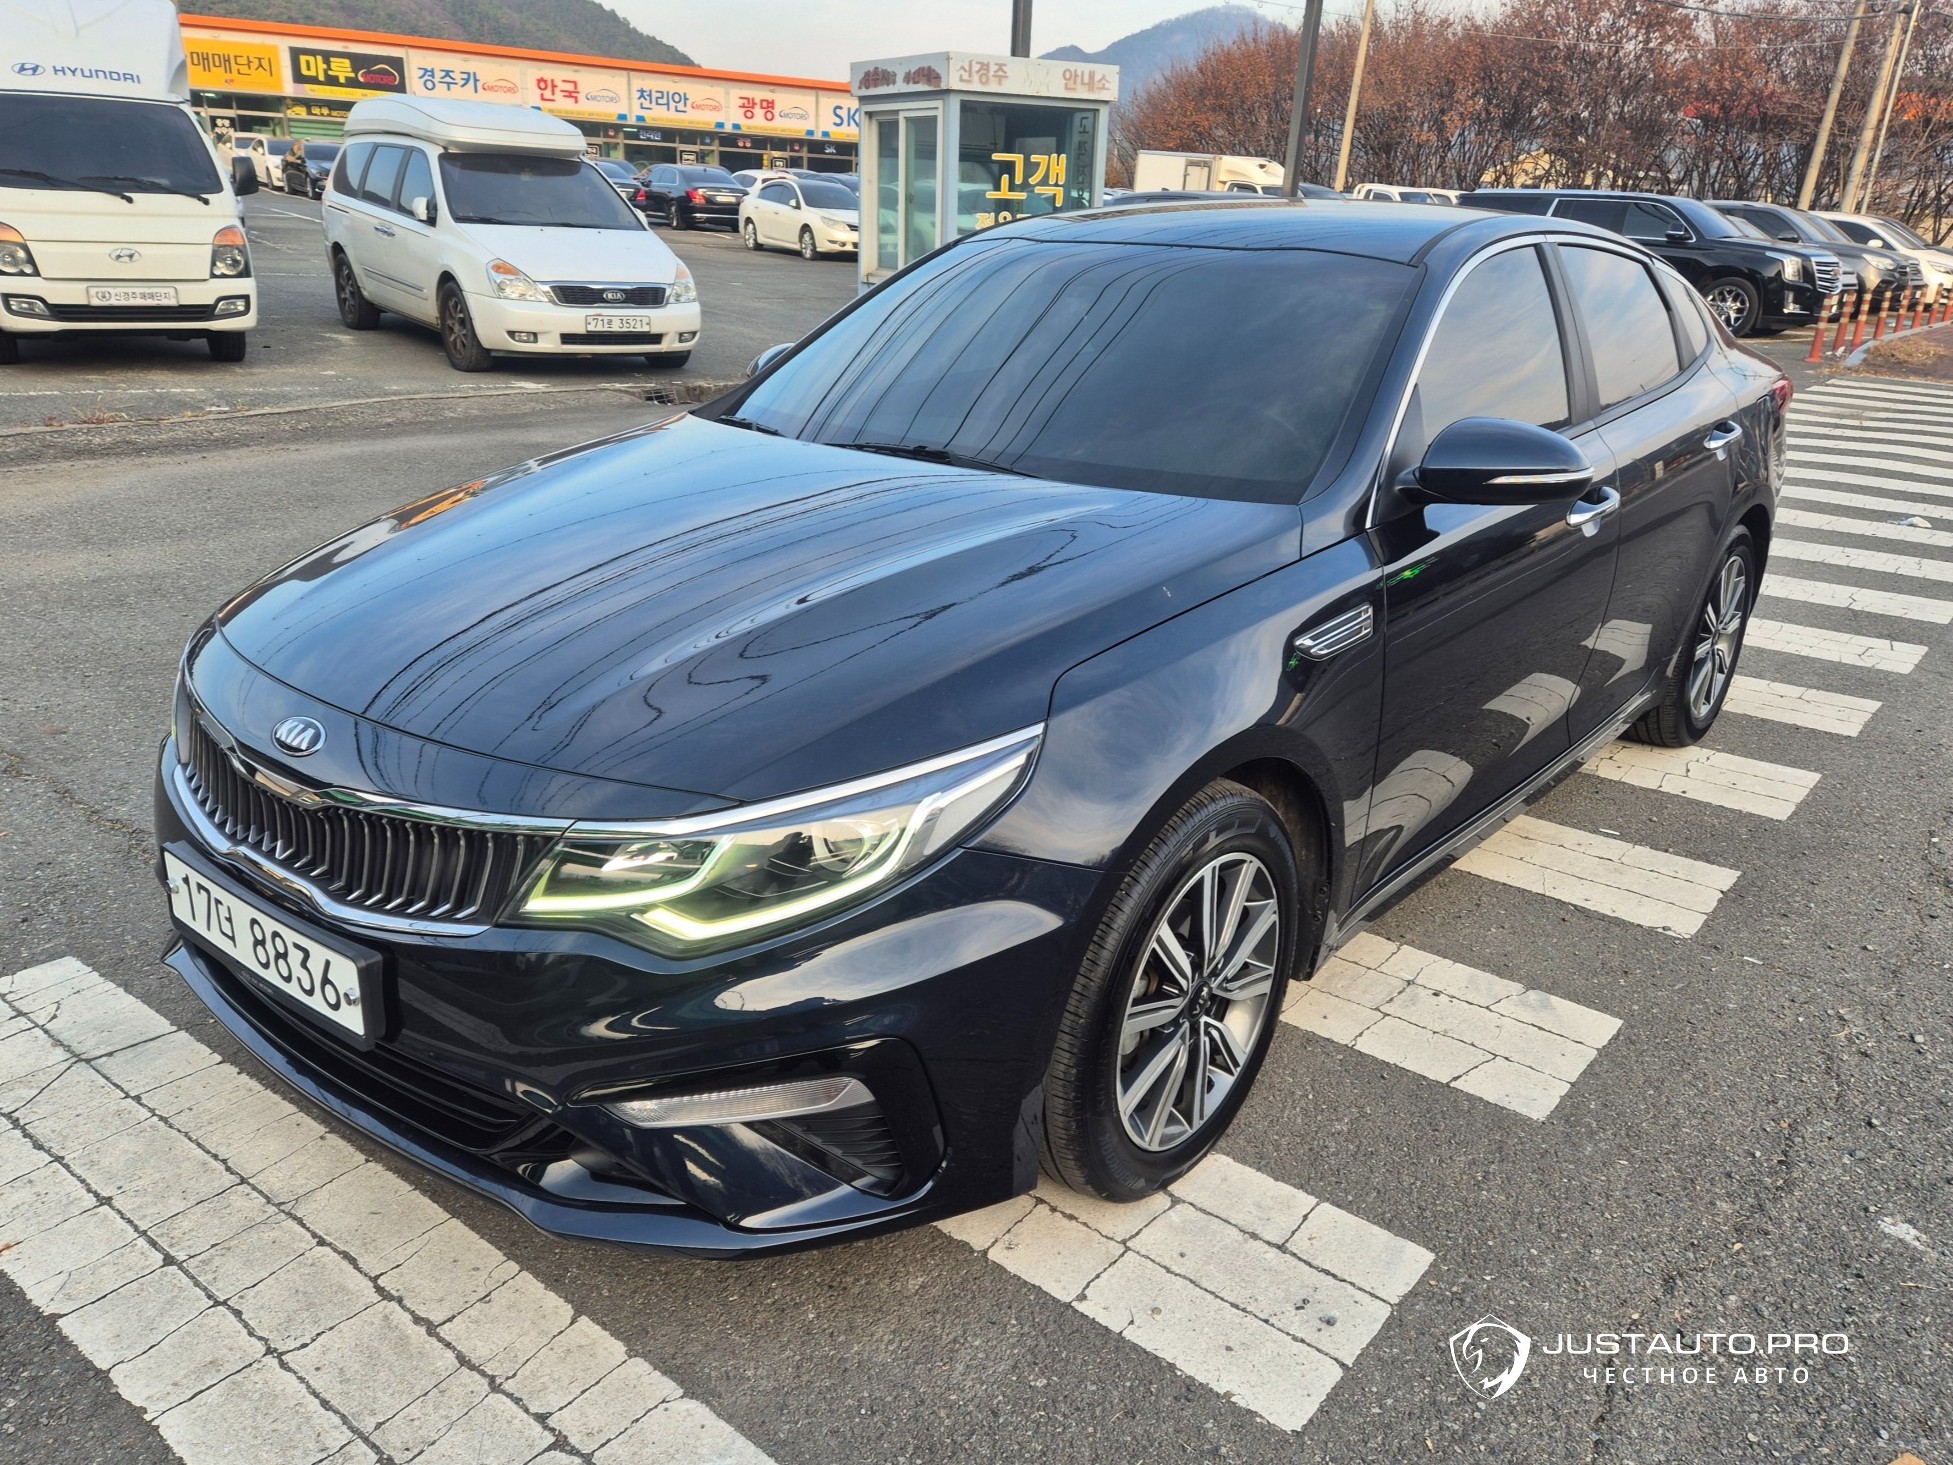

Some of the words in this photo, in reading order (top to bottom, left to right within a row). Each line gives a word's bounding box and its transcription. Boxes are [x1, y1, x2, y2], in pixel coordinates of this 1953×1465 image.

[53, 65, 142, 84] HYUNDAI
[190, 51, 273, 77] 매매단지
[299, 54, 355, 83] 마루
[363, 73, 397, 85] MOTORS
[956, 59, 1009, 86] 신경주
[1062, 68, 1112, 92] 안내소
[417, 66, 480, 94] 경주카
[486, 83, 517, 94] MOTORS
[536, 77, 580, 104] 한국
[589, 94, 619, 104] MOTORS
[636, 87, 690, 114] 천리안
[738, 96, 776, 122] 광명
[783, 112, 809, 120] MOTORS
[832, 105, 860, 128] SK
[824, 144, 837, 154] SK
[985, 152, 1067, 208] 고객
[607, 291, 622, 300] KIA
[618, 318, 643, 329] 3521
[275, 720, 317, 750] KIA
[181, 873, 237, 949] 17더
[249, 917, 342, 1012] 8836
